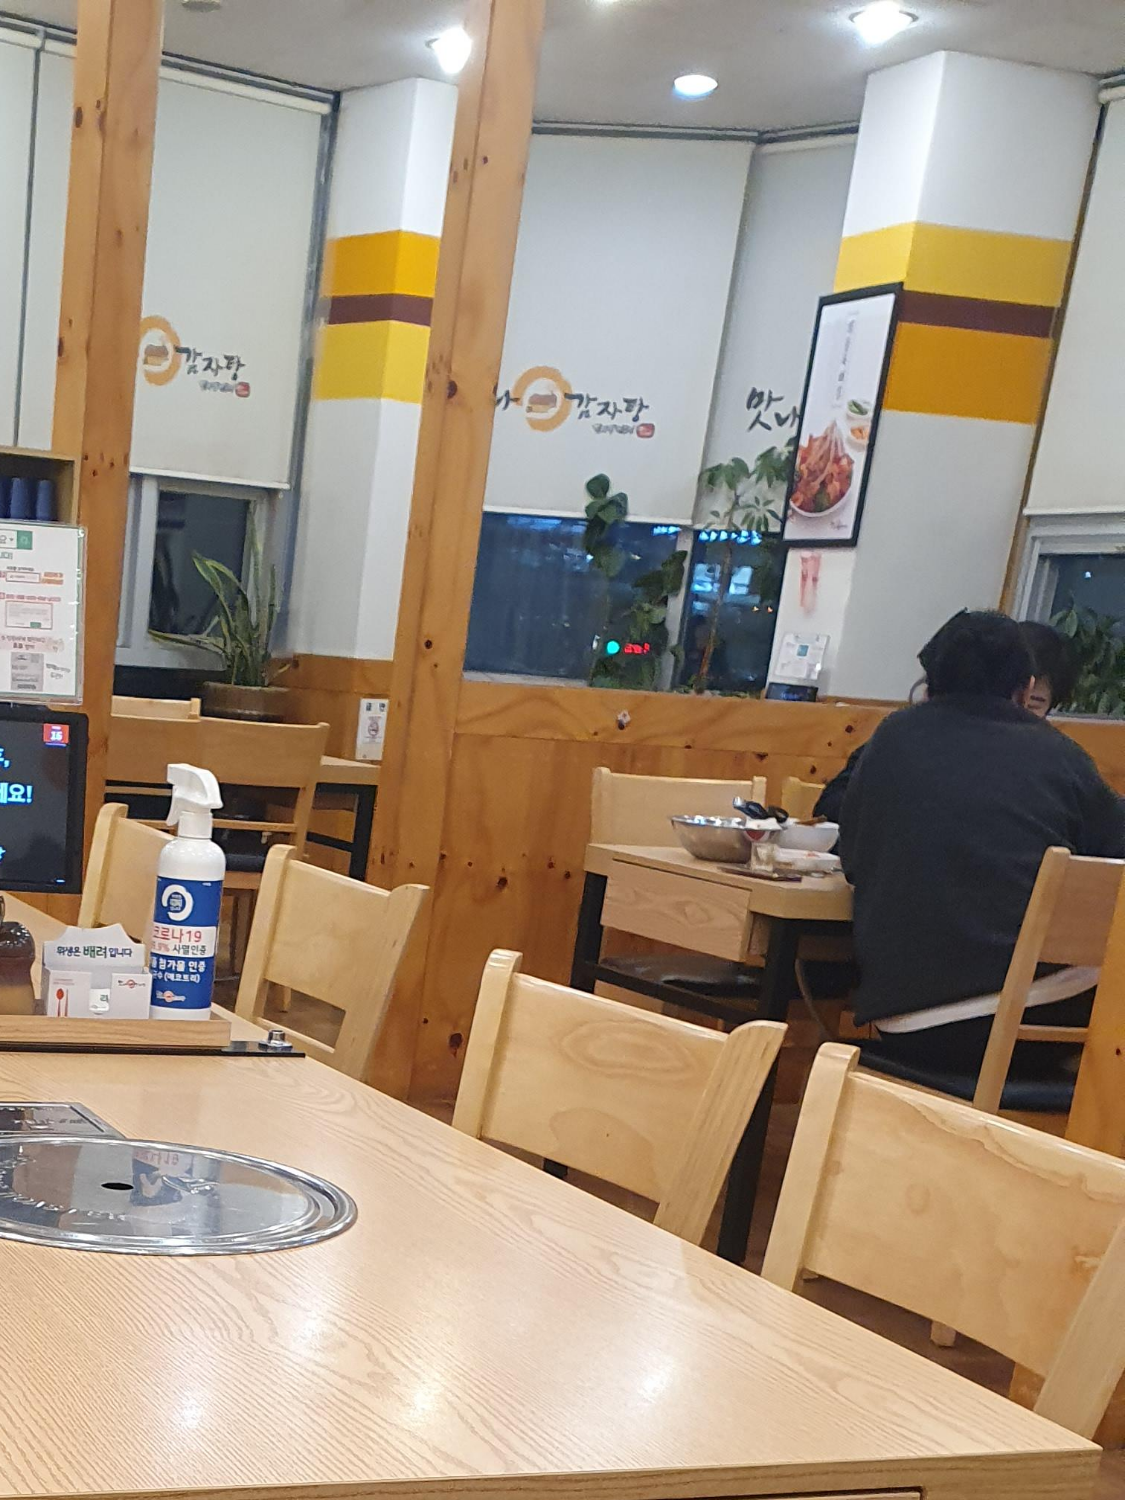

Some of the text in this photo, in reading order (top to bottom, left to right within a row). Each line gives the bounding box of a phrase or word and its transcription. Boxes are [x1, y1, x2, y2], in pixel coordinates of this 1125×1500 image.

[564, 392, 649, 422] 감자탕
[83, 945, 107, 959] 배려
[108, 947, 133, 958] 입니다
